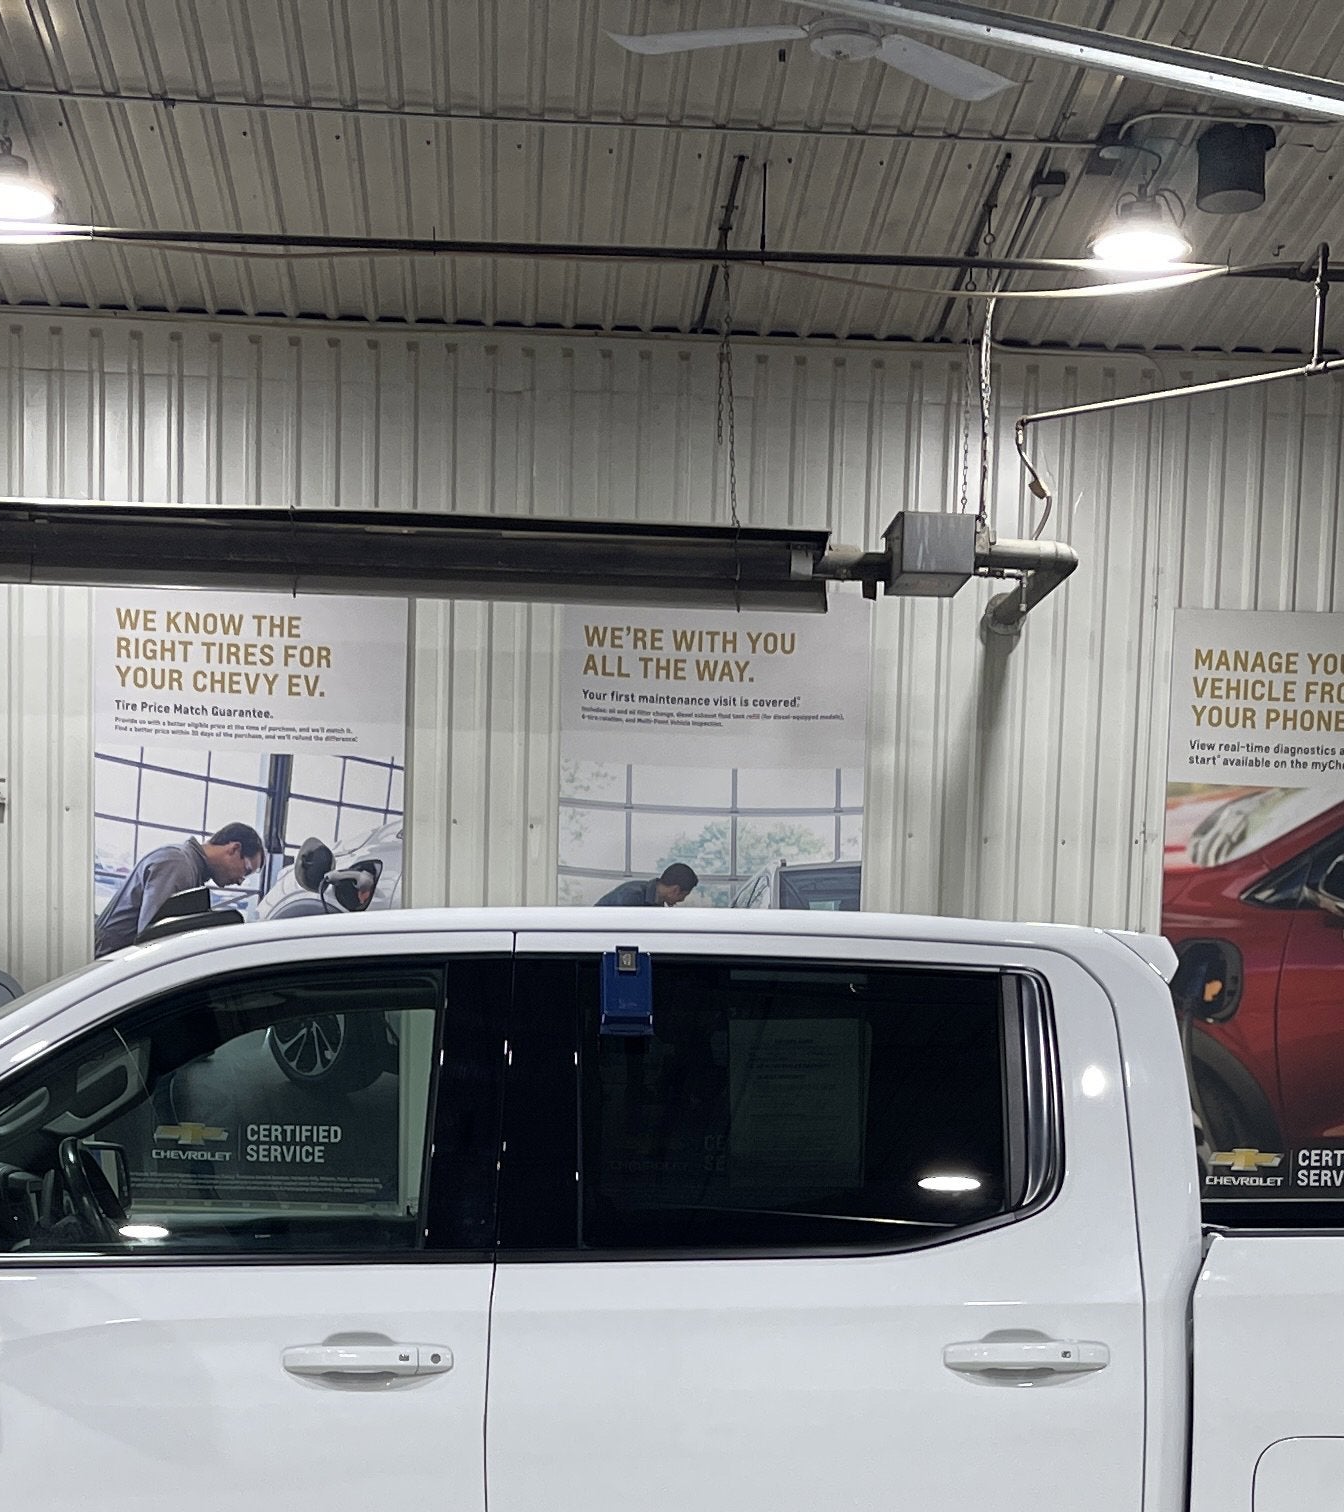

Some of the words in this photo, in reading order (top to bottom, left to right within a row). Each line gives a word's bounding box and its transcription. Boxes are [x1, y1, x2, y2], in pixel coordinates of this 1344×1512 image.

[116, 608, 156, 632] WE
[166, 611, 243, 636] KNOW
[252, 615, 301, 638] THE
[584, 625, 663, 650] WE'RE
[673, 629, 737, 652] WITH
[746, 632, 795, 654] YOU
[116, 637, 192, 662] RIGHT
[201, 641, 274, 666] TIRES
[284, 645, 331, 668] FOR
[1195, 649, 1298, 674] MANAGE
[583, 654, 630, 678] ALL
[639, 657, 687, 681] THE
[695, 659, 754, 682] WAY.
[115, 665, 183, 691] YOUR
[193, 670, 278, 695] CHEVY
[288, 674, 325, 697] EV.
[1192, 676, 1296, 702] VEHICLE
[583, 689, 607, 700] Your
[611, 691, 635, 702] first
[639, 693, 710, 706] maintenance
[713, 696, 736, 706] visit
[740, 697, 748, 706] is
[115, 700, 137, 711] Tire
[141, 701, 170, 713] Price
[174, 704, 208, 716] Match
[212, 706, 273, 718] Guarantee.
[1191, 705, 1256, 728] YOUR
[1190, 740, 1215, 750] View
[1219, 742, 1270, 753] real-time
[1274, 744, 1336, 757] diagnostics
[1223, 756, 1270, 767] available
[1291, 759, 1308, 769] the
[246, 1125, 342, 1143] CERTIFIED
[152, 1150, 231, 1161] CHEVROLET
[246, 1146, 324, 1162] SERVICE
[1206, 1176, 1283, 1186] CHEVROLET
